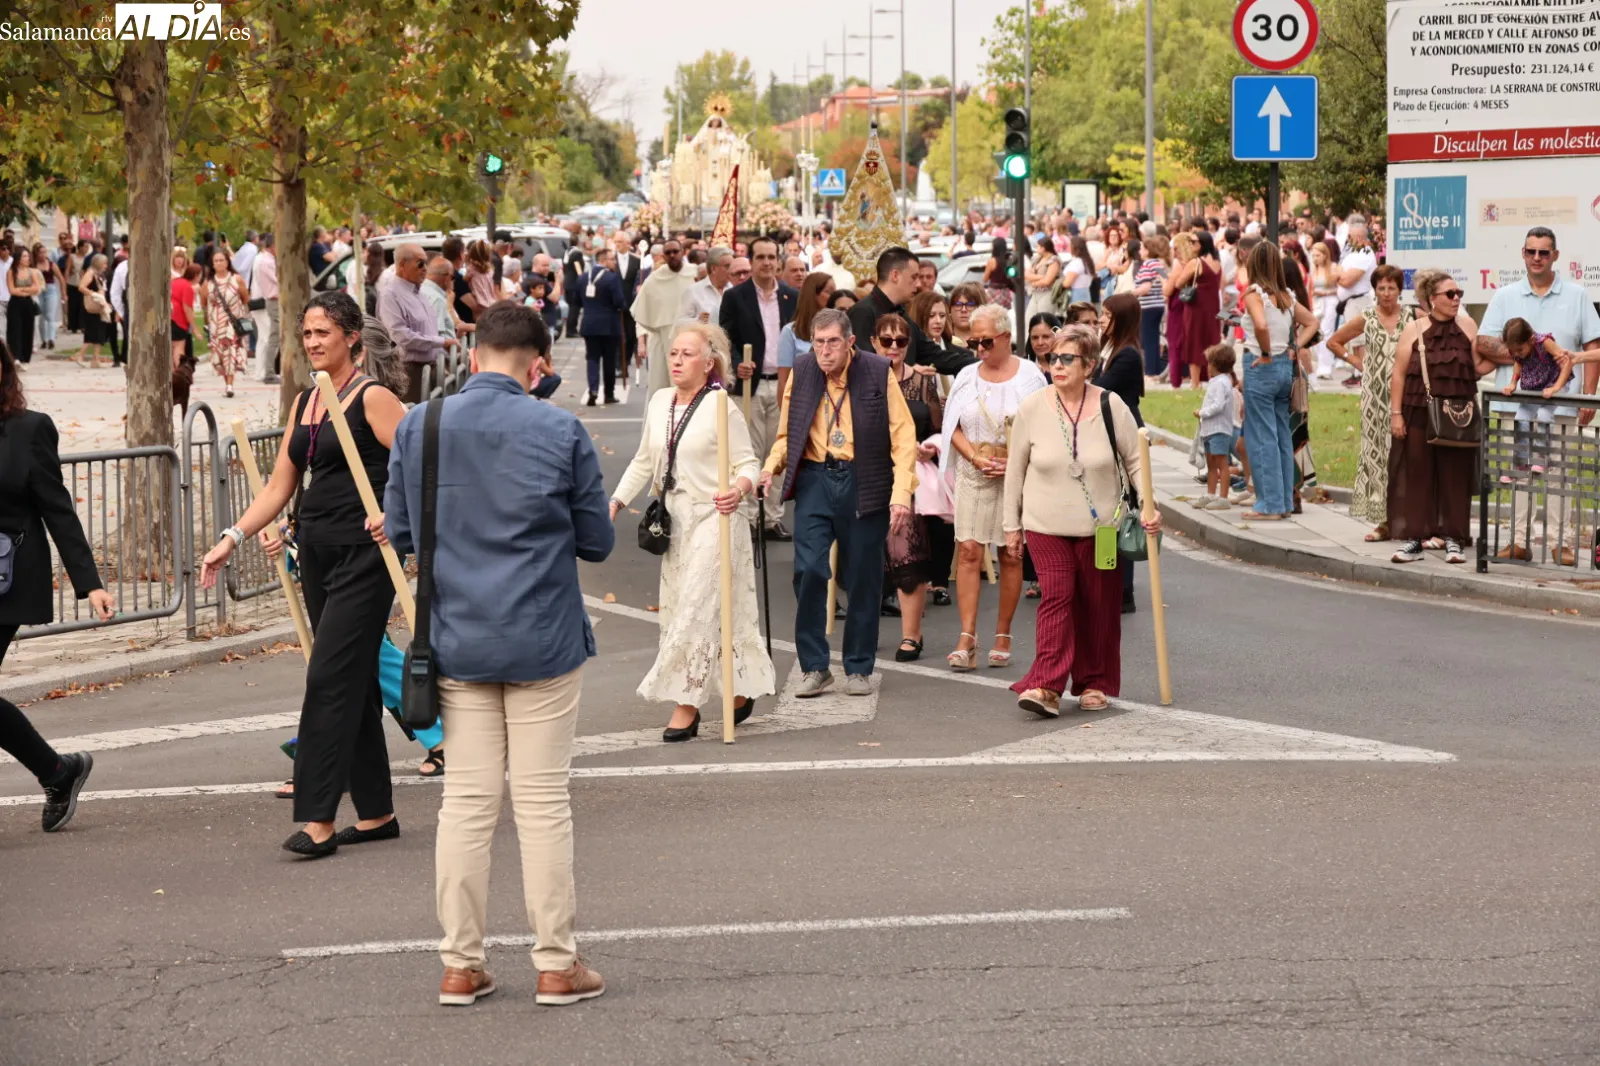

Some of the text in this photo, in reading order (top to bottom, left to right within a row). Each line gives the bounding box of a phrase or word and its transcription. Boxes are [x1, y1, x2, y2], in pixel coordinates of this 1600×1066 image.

[1419, 15, 1454, 26] CARRIL
[1458, 14, 1477, 24] BICI
[1481, 14, 1494, 24] DE
[1497, 12, 1548, 24] CONEXIÓN
[1552, 13, 1585, 24] ENTRE
[1252, 13, 1299, 42] 30
[1412, 26, 1596, 41] DE LA MERCED Y CALLE ALFONSO DE
[1410, 46, 1416, 56] Y
[1420, 43, 1525, 56] ACONDICIONAMIENTO
[1528, 43, 1542, 54] EN
[1545, 42, 1580, 54] ZONAS
[1451, 62, 1595, 78] Presupuesto: 231.124,14 €
[1393, 86, 1428, 98] Empresa
[1431, 84, 1487, 96] Constructora:
[1490, 84, 1500, 94] LA
[1504, 83, 1544, 94] SERRANA
[1546, 83, 1558, 92] DE
[1393, 100, 1509, 112] Plazo de Ejecución: 4 MESES
[1433, 131, 1508, 159] Disculpen
[1513, 130, 1535, 151] las
